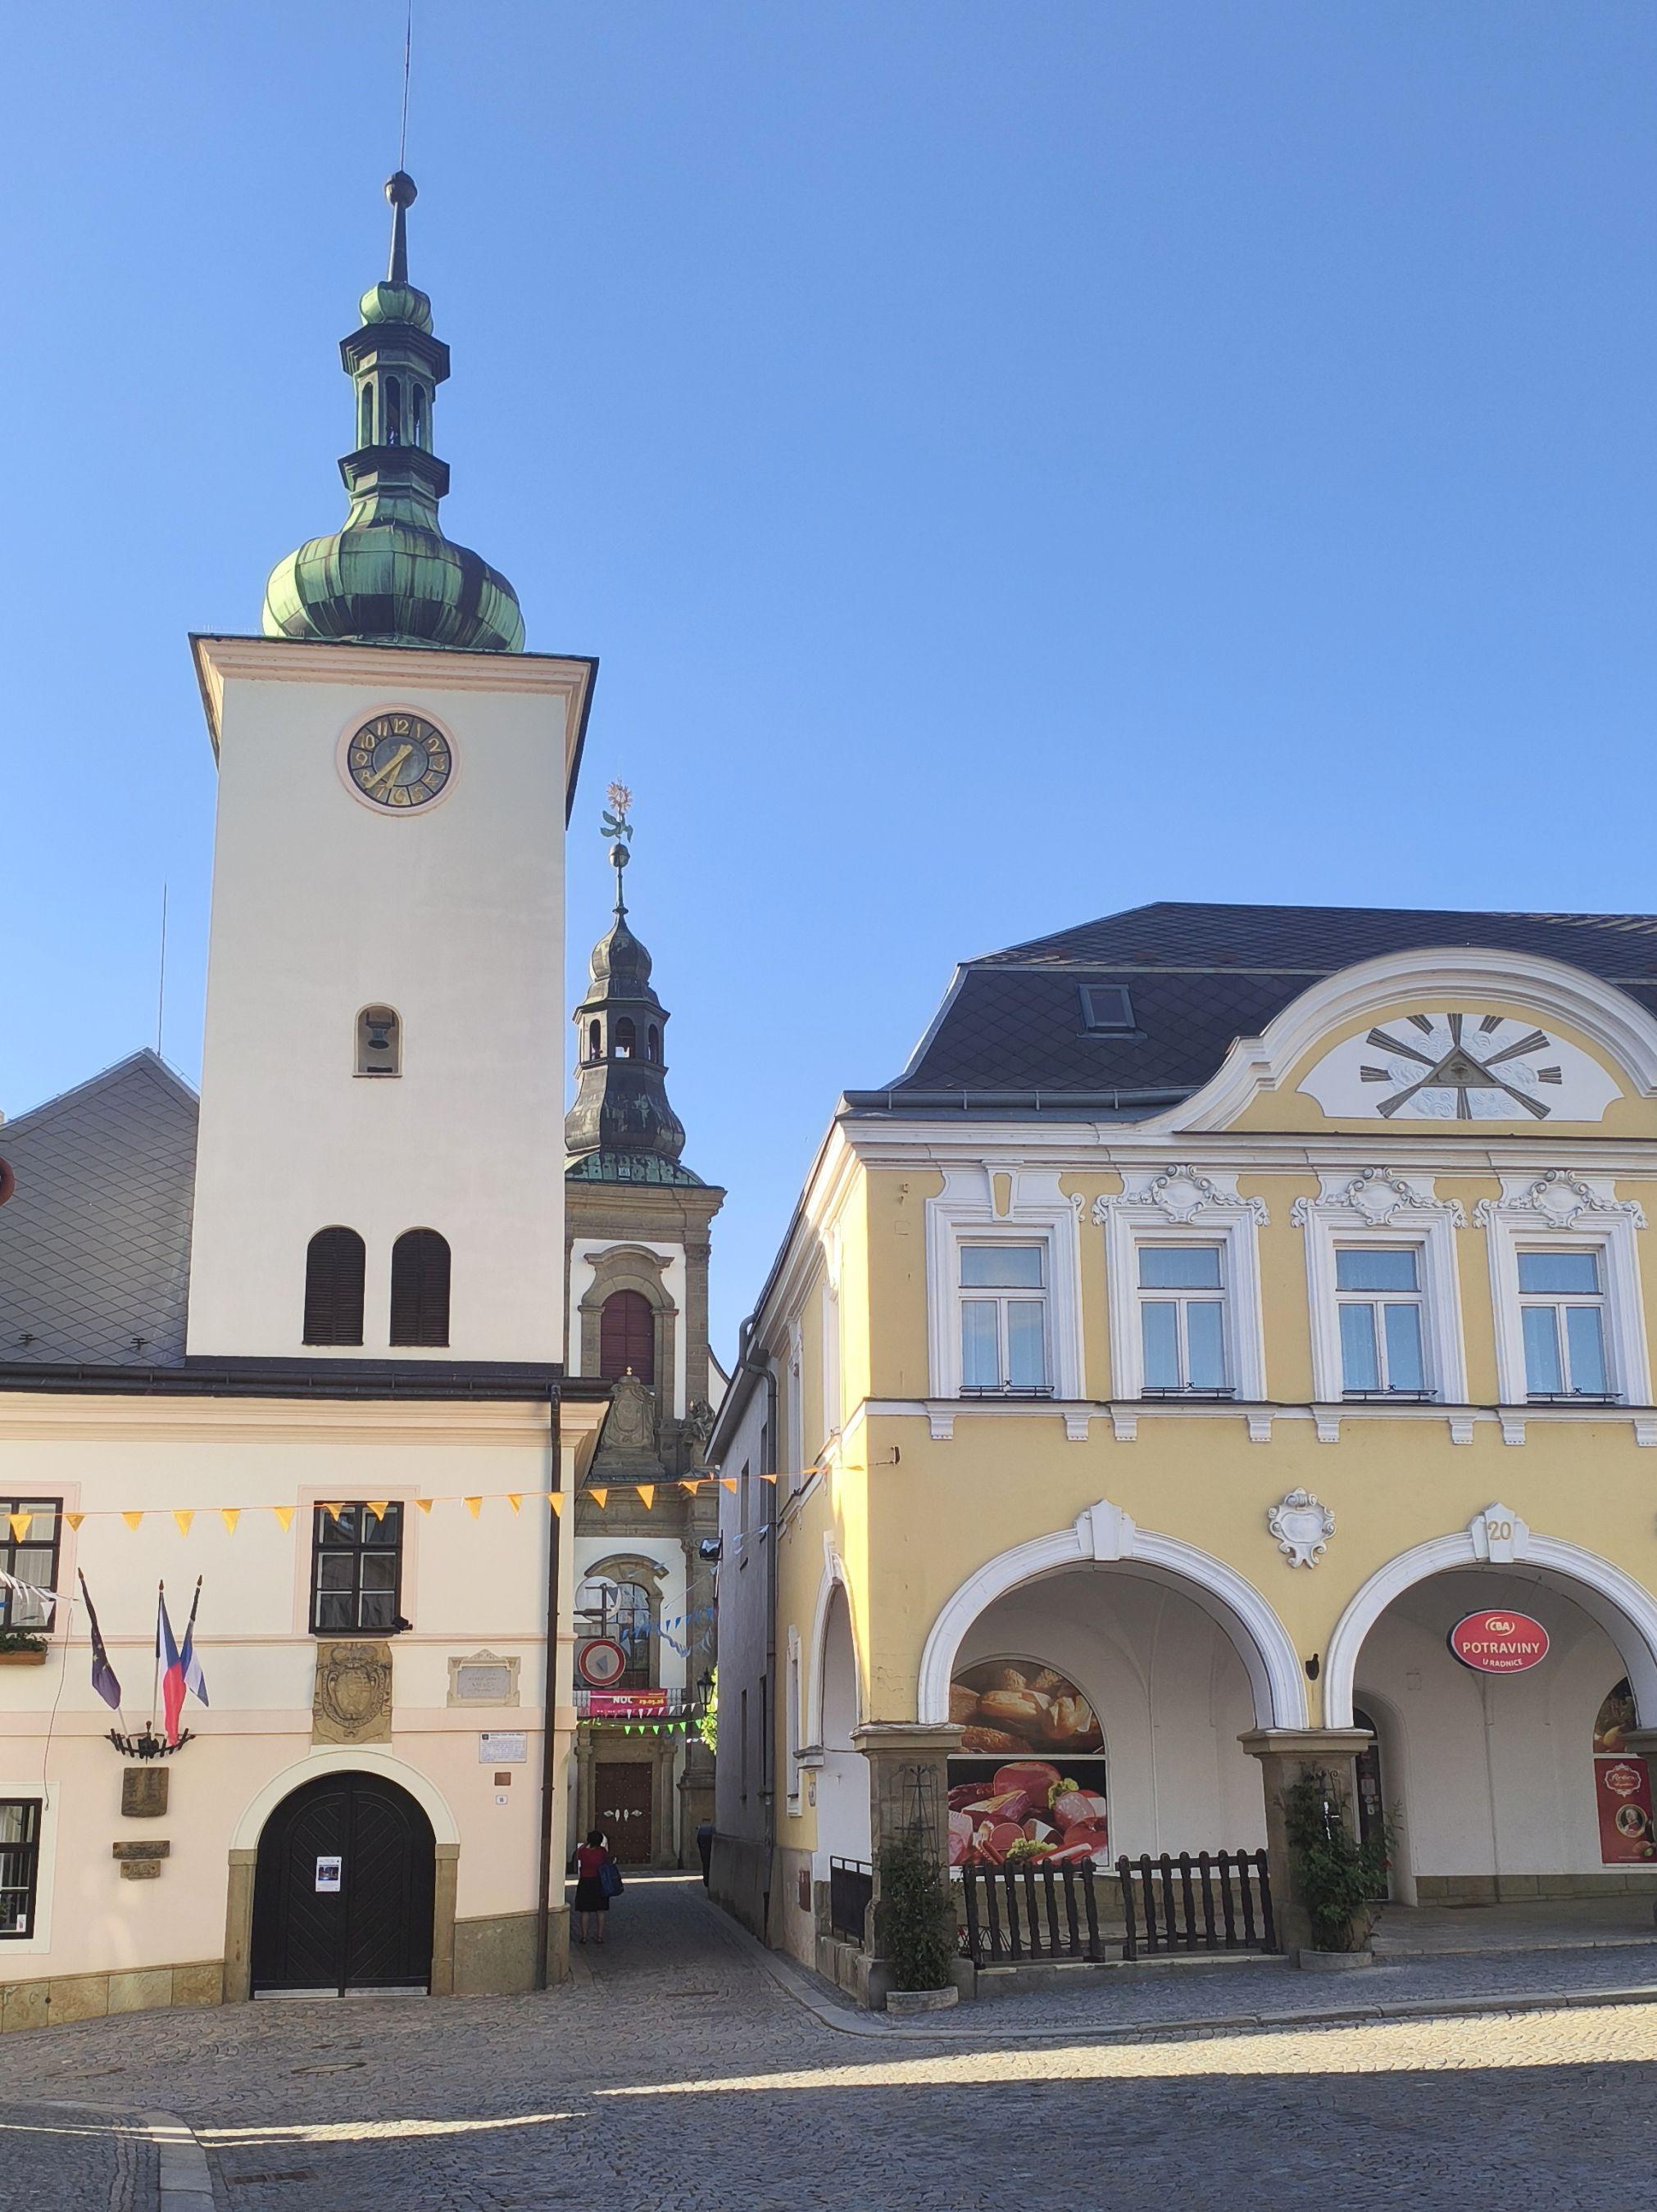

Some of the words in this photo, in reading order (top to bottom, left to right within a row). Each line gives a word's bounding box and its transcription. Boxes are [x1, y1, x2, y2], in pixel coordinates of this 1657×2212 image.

[377, 720, 388, 737] 11
[393, 718, 410, 734] 12
[416, 723, 421, 737] 1
[360, 733, 375, 749] 10
[428, 738, 441, 753] 2
[356, 752, 368, 766] 9
[433, 755, 446, 770] 3
[361, 770, 372, 782] 8
[424, 773, 439, 786] 4
[376, 783, 386, 798] 7
[393, 788, 406, 803] 6
[415, 786, 424, 801] 5
[1487, 1521, 1511, 1540] 20
[1490, 1621, 1510, 1631] CBA
[1462, 1642, 1540, 1653] POTRAVINY
[1489, 1658, 1523, 1667] RADNICE
